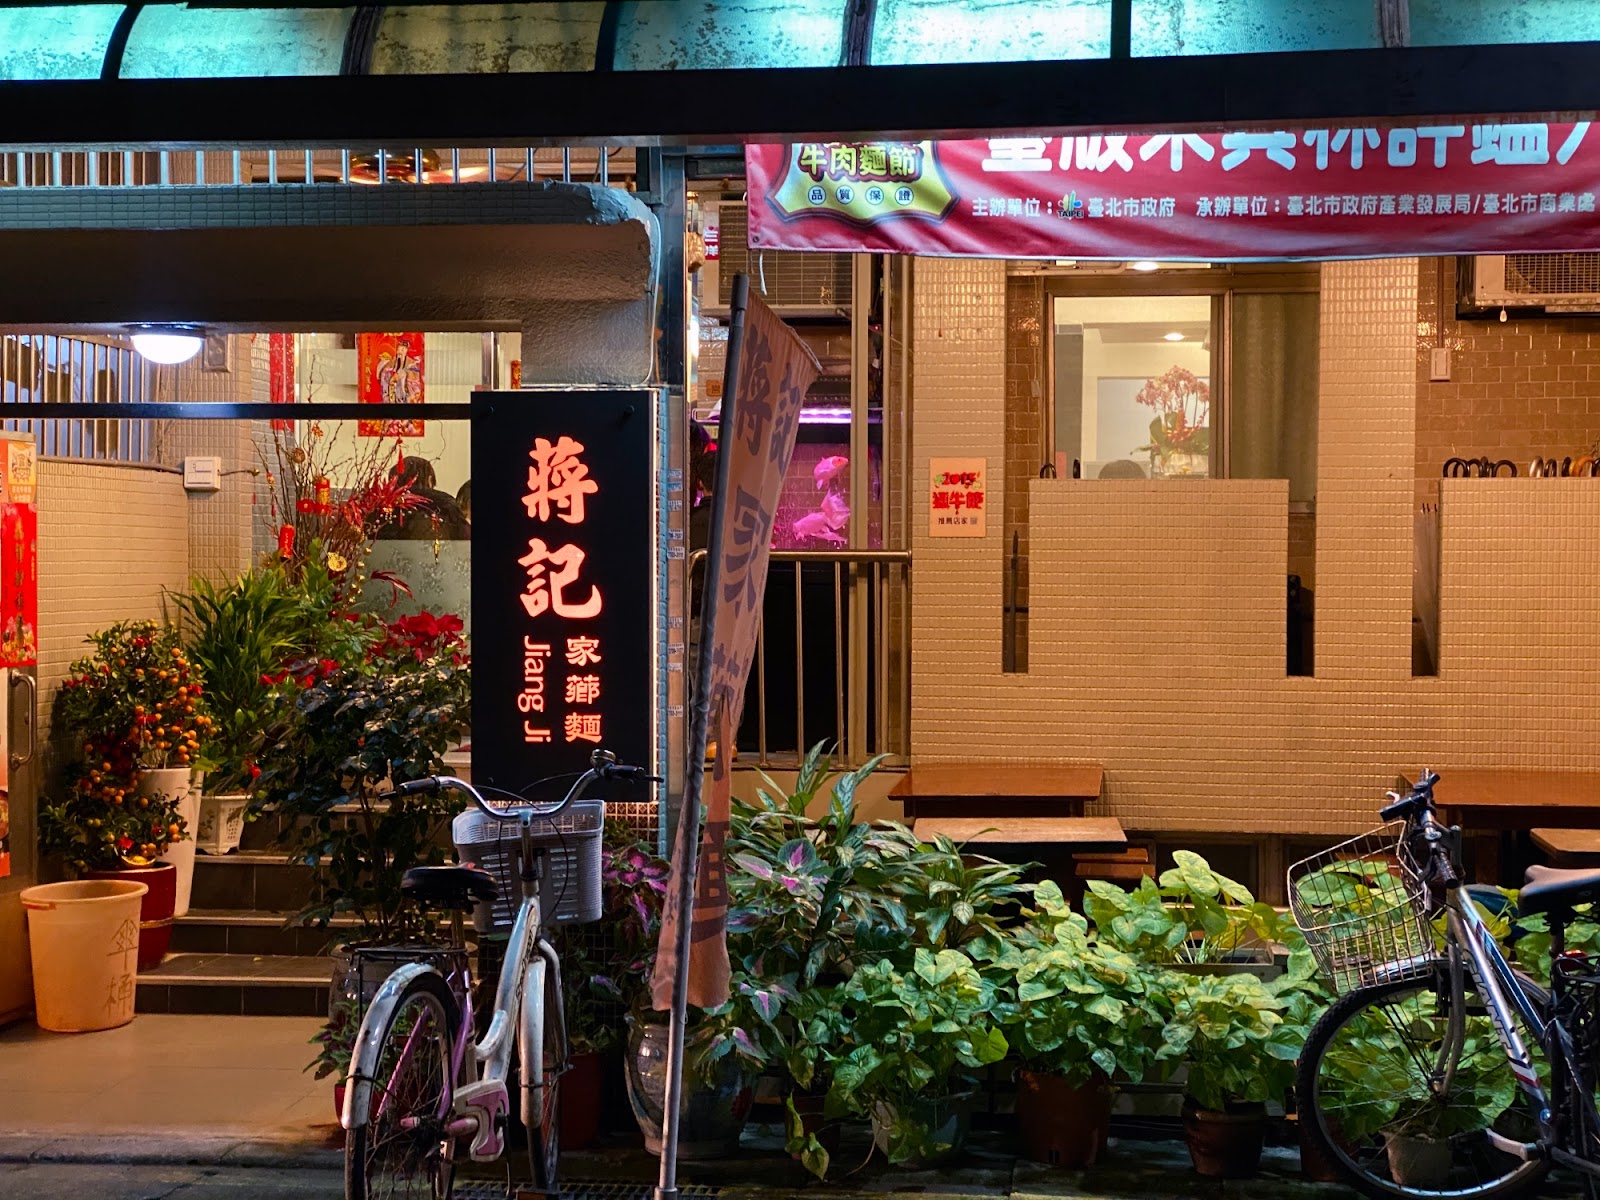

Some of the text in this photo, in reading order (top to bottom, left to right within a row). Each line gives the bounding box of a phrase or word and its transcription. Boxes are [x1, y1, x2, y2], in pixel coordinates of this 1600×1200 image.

[800, 144, 917, 176] 牛肉麵節
[809, 187, 914, 204] 品質保證
[1058, 209, 1084, 219] TAIPEI
[1087, 196, 1176, 218] 臺北市政府
[517, 436, 602, 618] 蔣記
[517, 635, 551, 743] Jiang Ji
[1460, 949, 1513, 1050] GIANT
